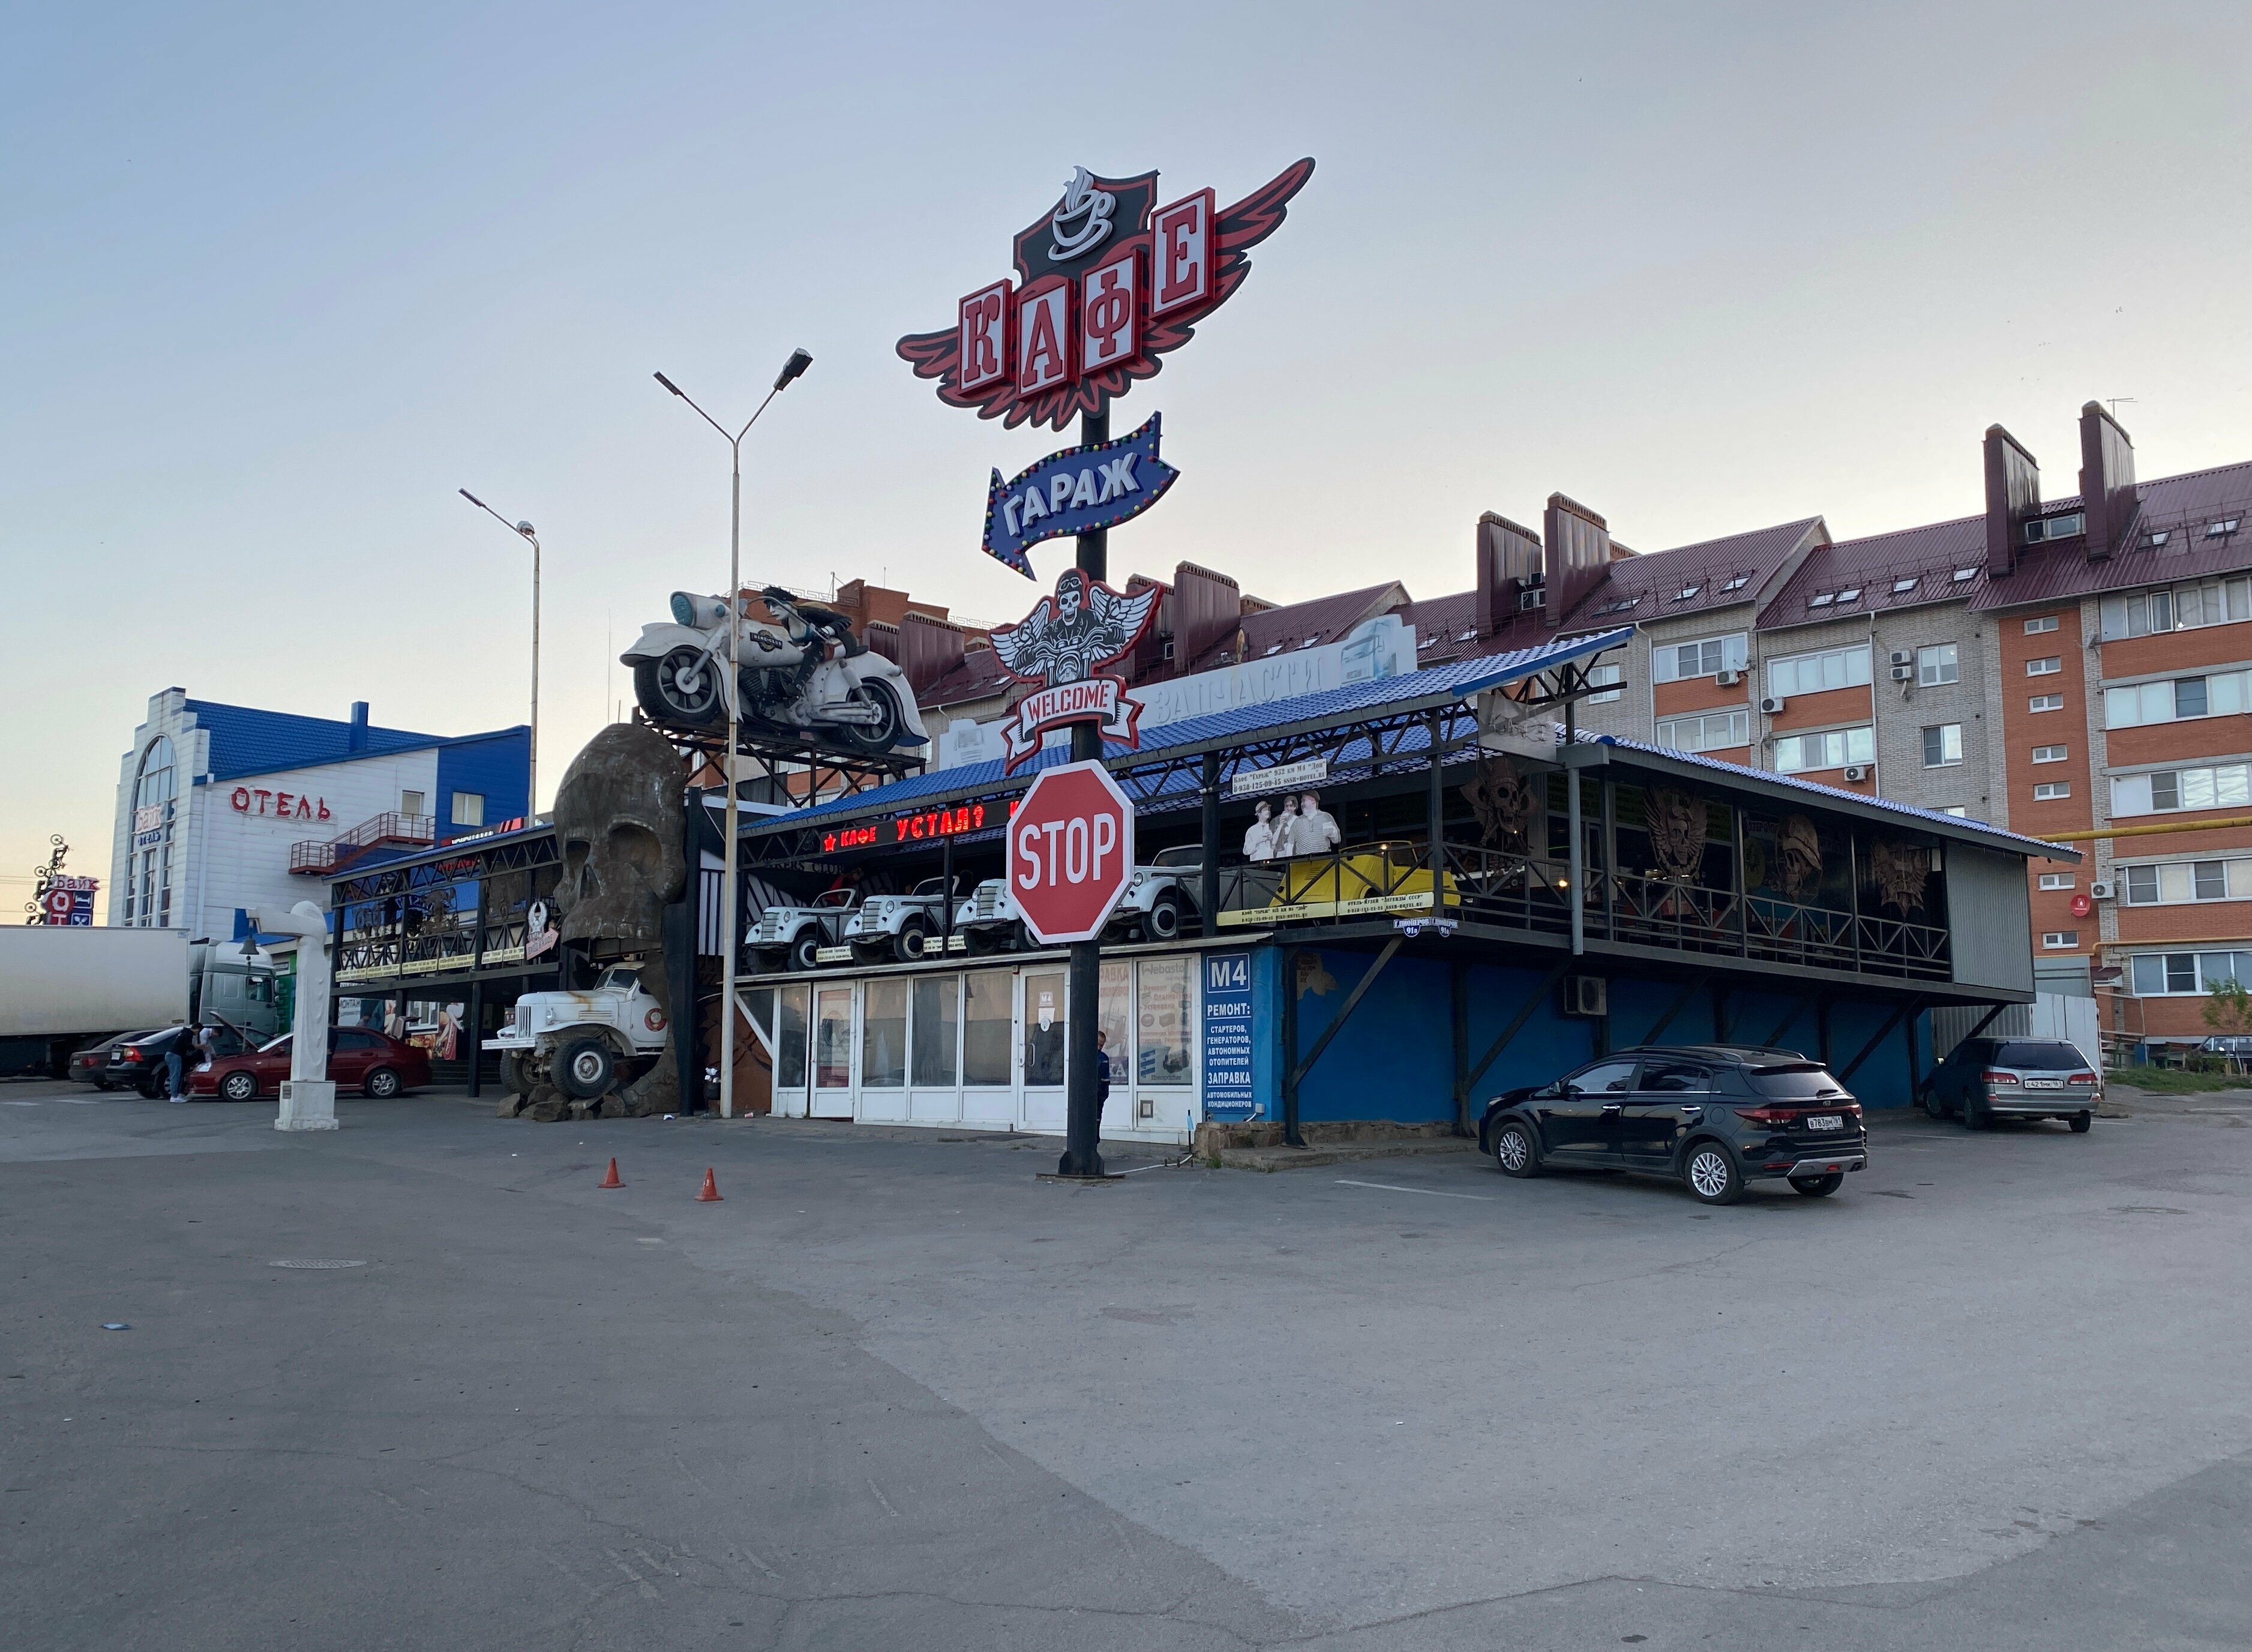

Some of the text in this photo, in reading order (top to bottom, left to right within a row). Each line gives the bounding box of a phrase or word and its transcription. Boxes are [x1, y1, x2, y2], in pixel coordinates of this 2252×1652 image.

[963, 204, 1198, 385] КАФЕ
[1003, 452, 1140, 536] ГАРАЖ
[1155, 658, 1322, 724] ЗАПЧАСТИ
[1027, 684, 1110, 721] WELCOME
[1274, 768, 1285, 776] 932
[231, 786, 331, 821] ОТЕЛЬ
[1018, 812, 1115, 890] STOP
[1207, 1003, 1250, 1017] РЕМОНТ:
[1210, 1024, 1247, 1034] СТАРТЕРОВ,
[1207, 1036, 1251, 1045] ГЕНЕРАТОРОВ,
[1208, 1047, 1250, 1056] АВТОНОМНЫХ
[1209, 1056, 1249, 1066] ОТОПИТЕЛЕЙ
[1208, 1071, 1251, 1084] ЗАПРАВКА
[1207, 1100, 1252, 1108] КОНДИЦИОНЕРОВ
